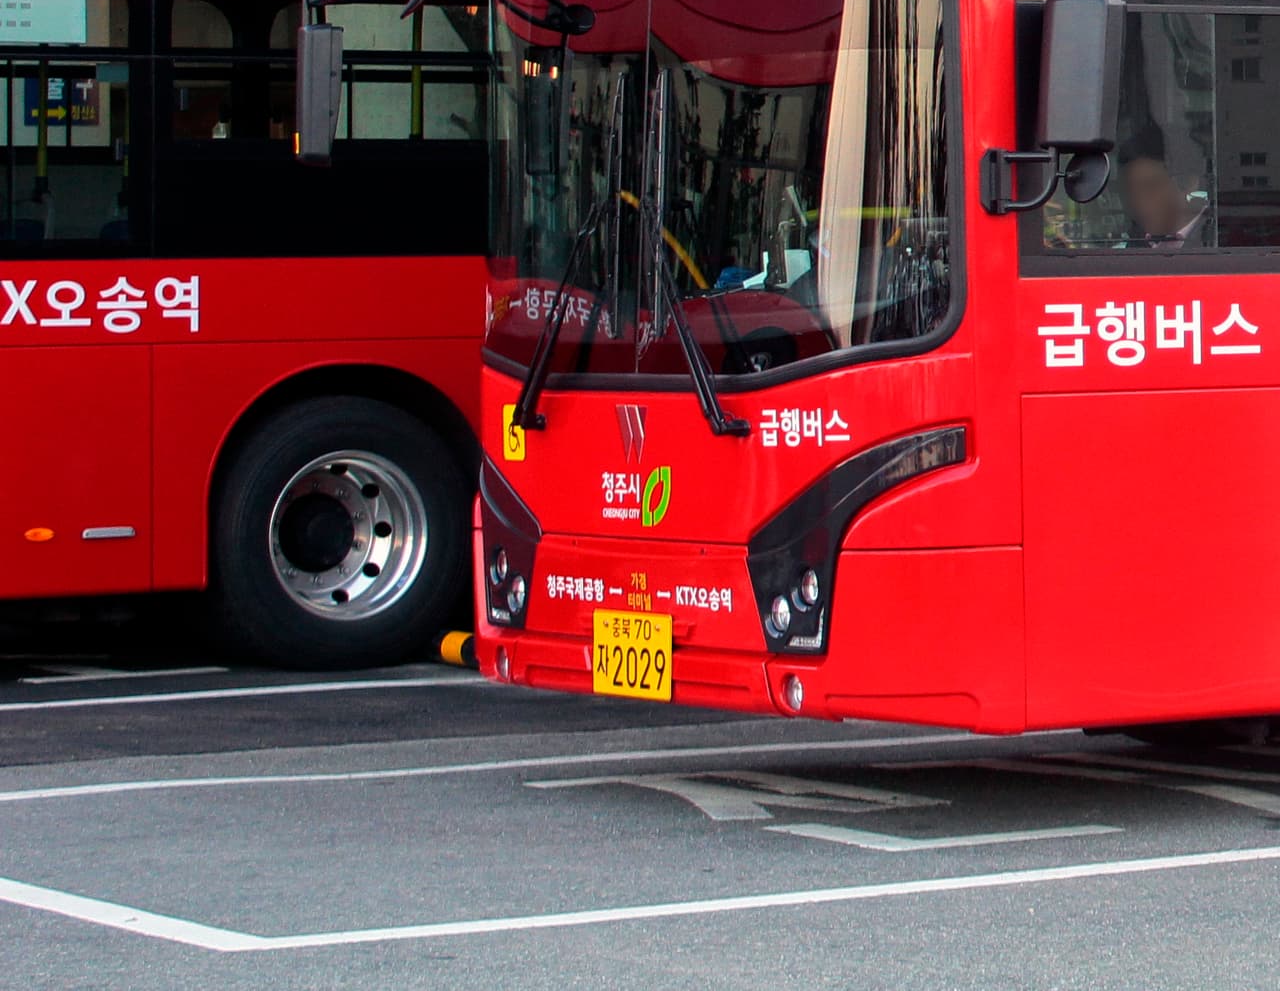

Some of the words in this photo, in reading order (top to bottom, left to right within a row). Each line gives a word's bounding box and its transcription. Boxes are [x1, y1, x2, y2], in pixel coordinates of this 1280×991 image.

[1037, 300, 1261, 368] 급행버스
[759, 408, 851, 447] 급행버스
[602, 471, 640, 504] 청주시
[547, 574, 604, 603] 청주국제공항
[631, 572, 648, 591] 가경
[627, 592, 652, 612] 터미널
[675, 585, 733, 613] KTX오송역
[613, 617, 631, 639] 충북
[635, 619, 652, 641] 70
[613, 645, 666, 692] 2029
